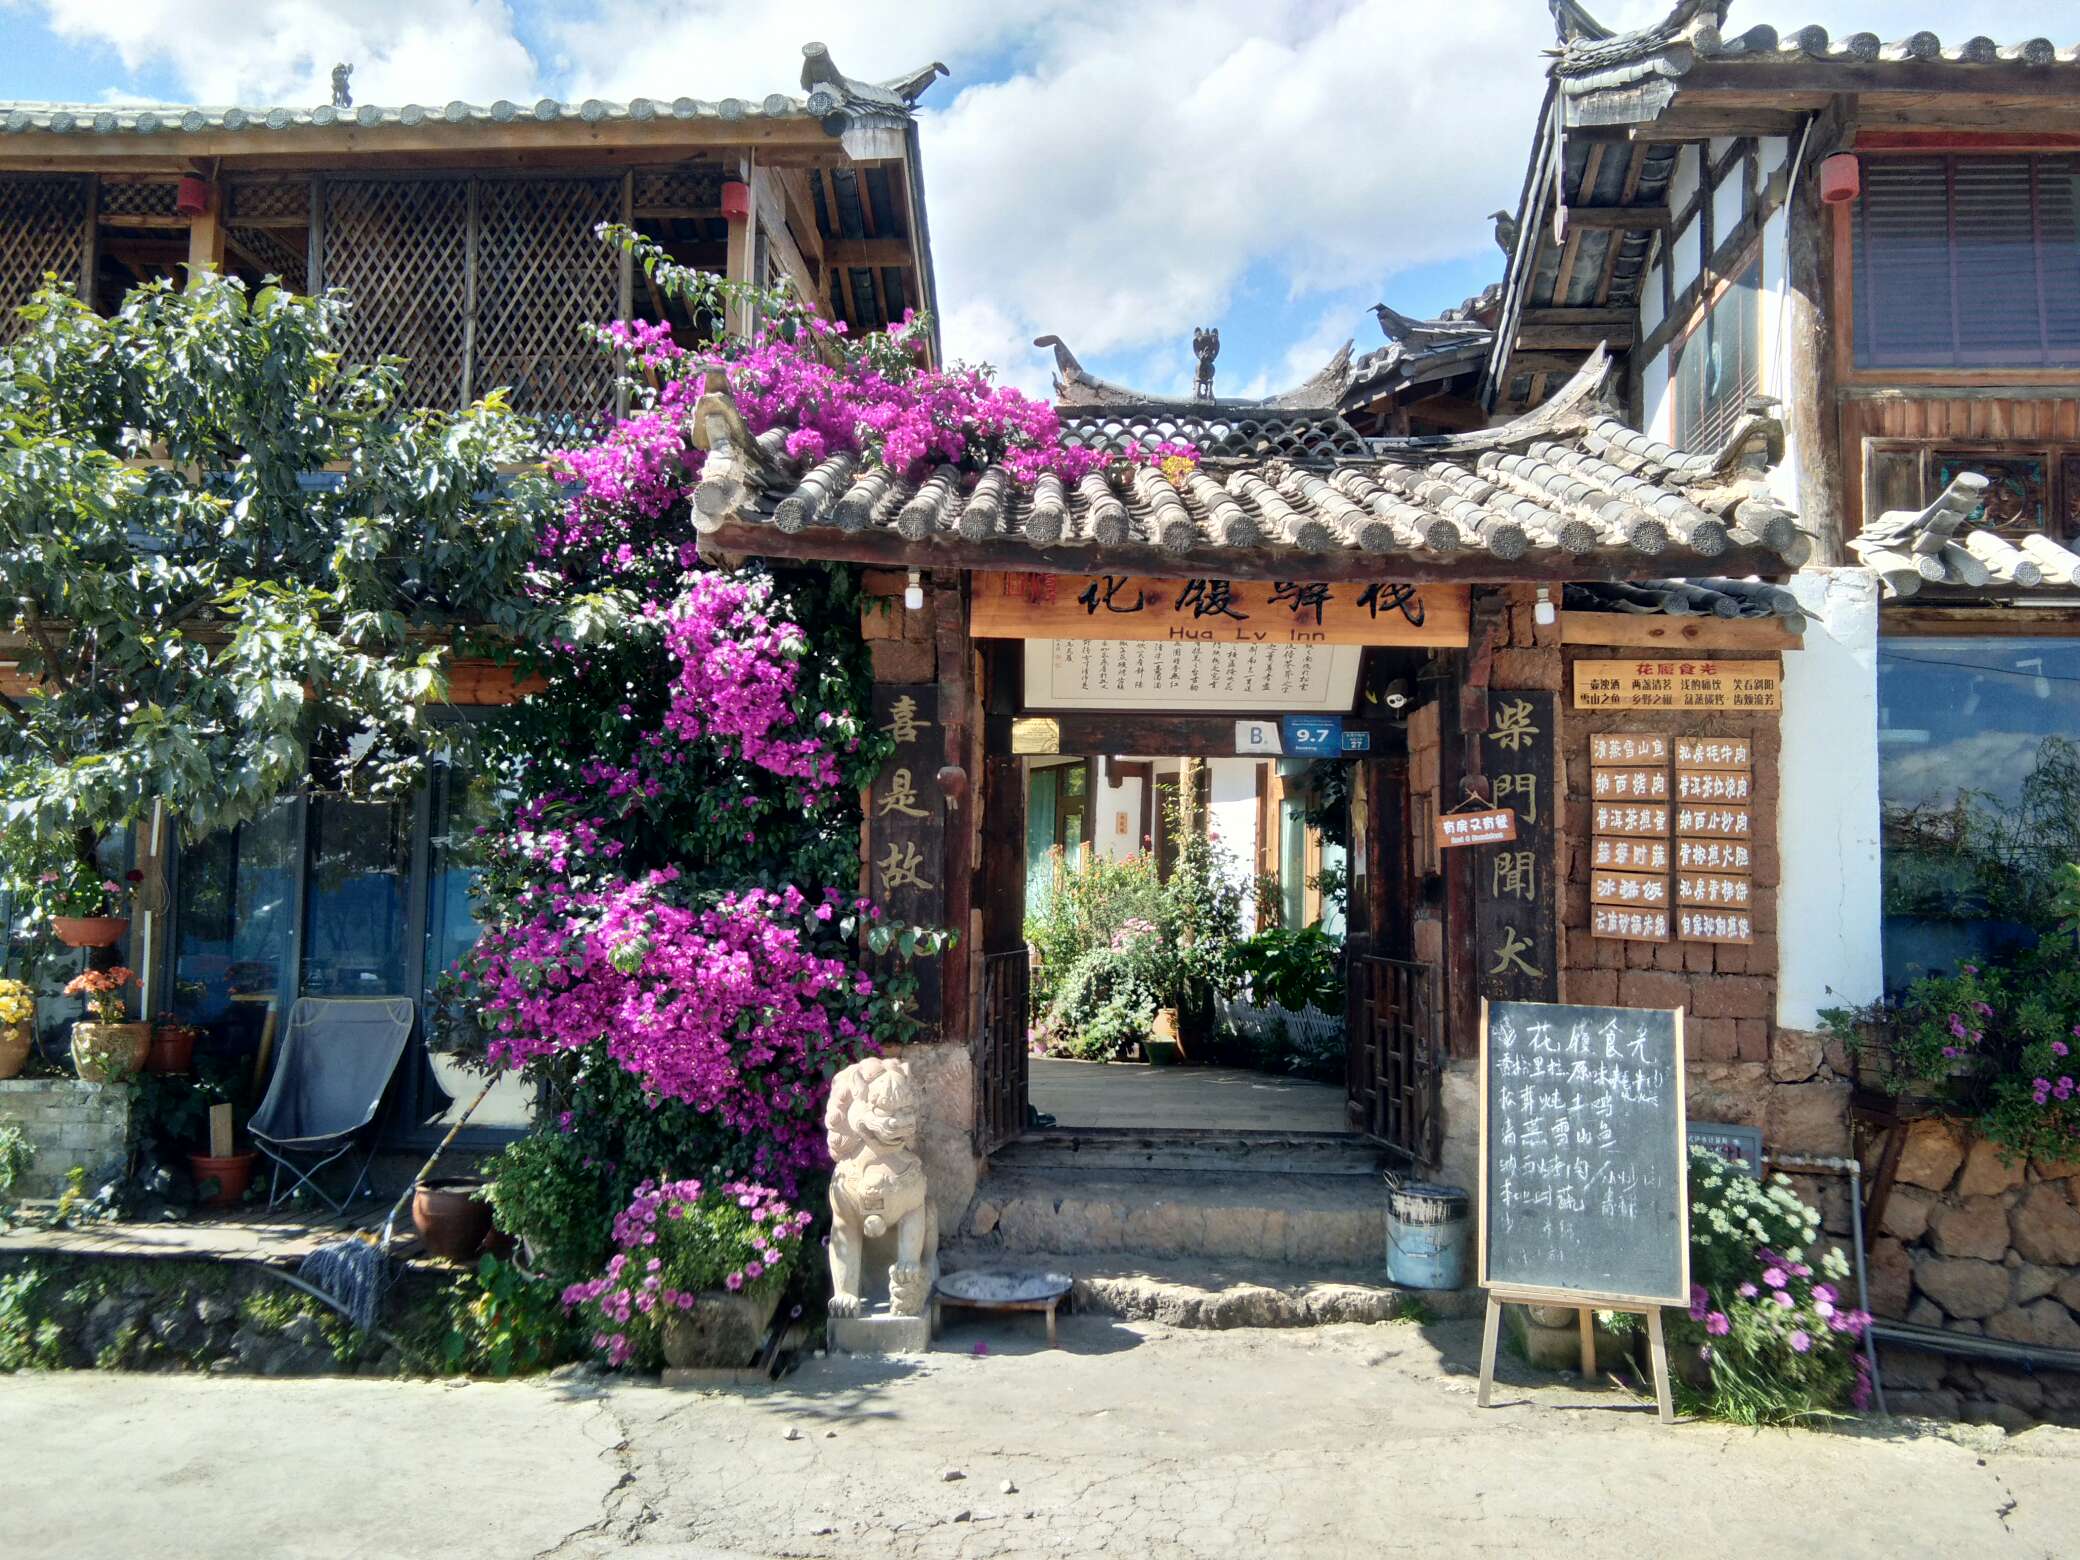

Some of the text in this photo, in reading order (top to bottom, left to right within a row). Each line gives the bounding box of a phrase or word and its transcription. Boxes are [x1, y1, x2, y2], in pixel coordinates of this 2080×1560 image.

[1169, 626, 1325, 641] Hua Lv Inn
[1296, 729, 1329, 743] 9.7
[877, 695, 933, 889] 喜是故
